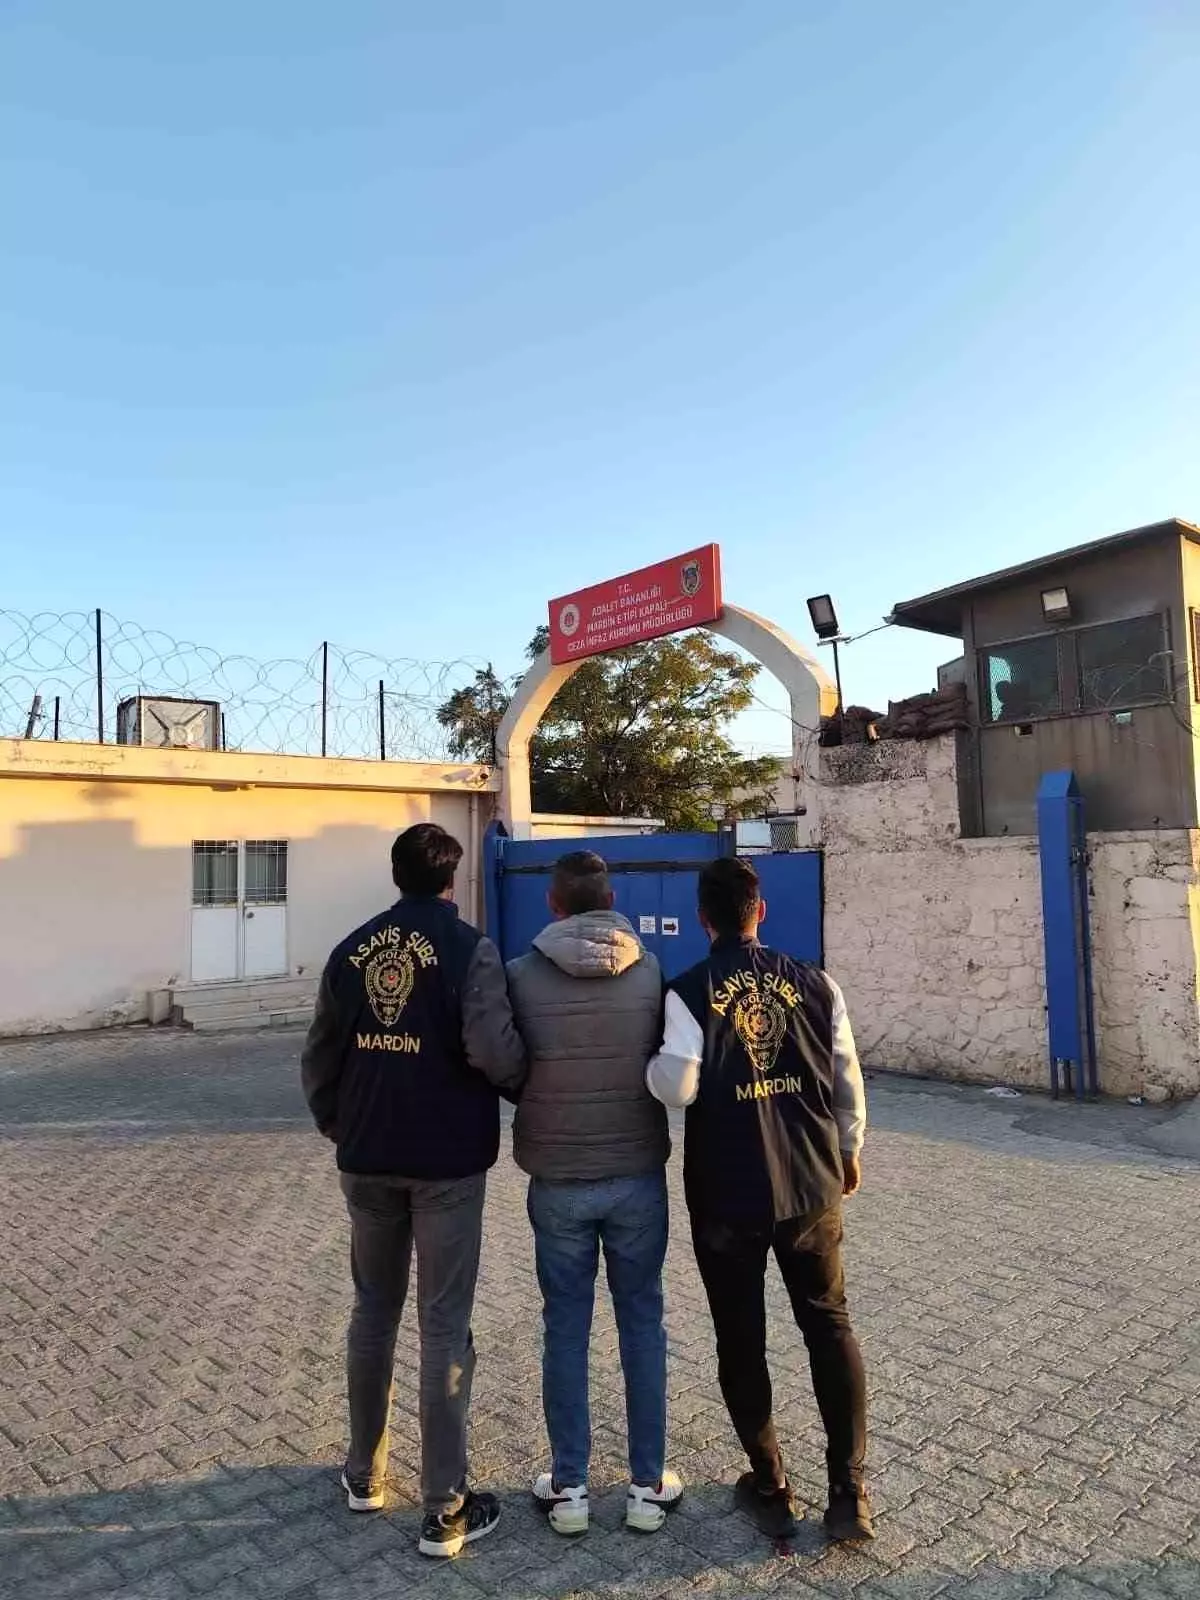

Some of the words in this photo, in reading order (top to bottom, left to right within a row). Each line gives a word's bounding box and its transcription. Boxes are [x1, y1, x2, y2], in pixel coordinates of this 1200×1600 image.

[591, 601, 618, 617] ADALET
[620, 585, 661, 608] BAKANLIĞI
[618, 583, 632, 595] T.C.
[567, 638, 585, 652] CEZA
[609, 622, 641, 641] KURUMU
[349, 925, 400, 969] ASAYİŞ
[404, 931, 438, 968] ŞUBE
[712, 969, 757, 1016] ASAYİŞ
[763, 973, 803, 1008] ŞUBE
[357, 1032, 421, 1053] MARDİN
[735, 1073, 802, 1101] MARDİN
